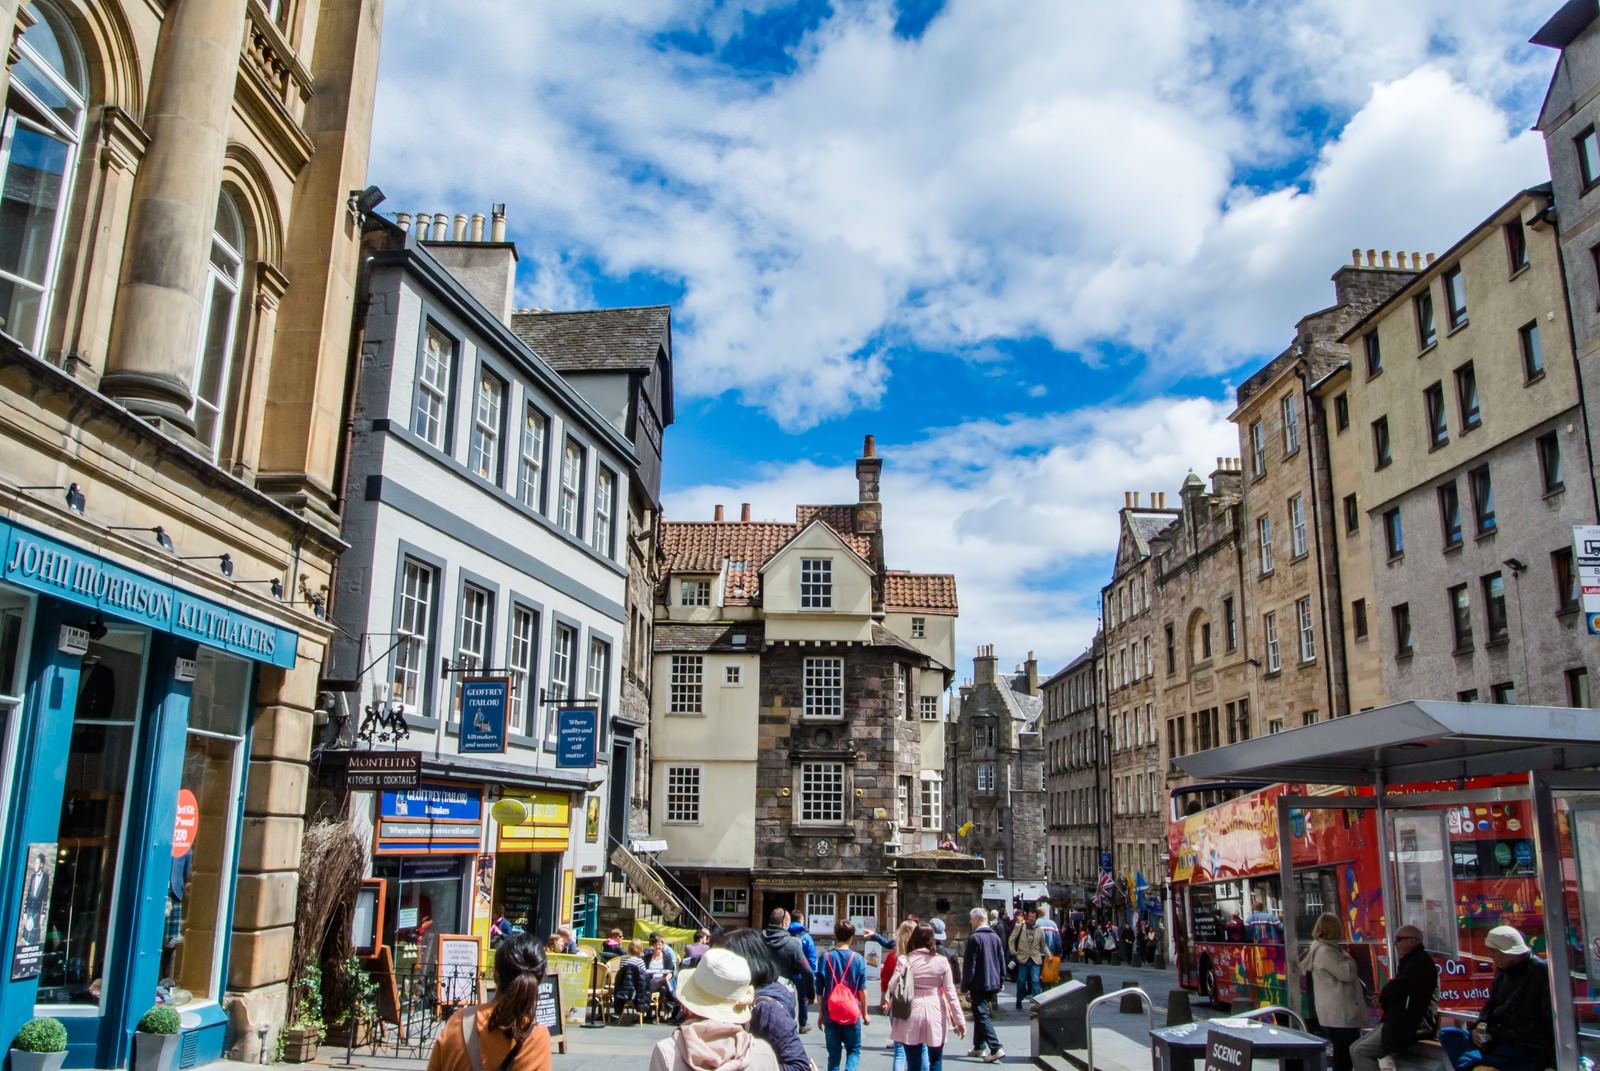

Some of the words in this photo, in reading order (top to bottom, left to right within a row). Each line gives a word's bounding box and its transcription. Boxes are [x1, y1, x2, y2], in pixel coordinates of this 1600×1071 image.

[9, 538, 71, 586] JOHN
[73, 560, 171, 622] MORRISON
[178, 600, 275, 655] KILTMAKERS
[466, 688, 503, 696] GEOFFREY
[467, 733, 498, 741] kiltmakers
[348, 755, 417, 768] MONTEITHS
[347, 775, 374, 785] KITCHEN
[383, 775, 417, 785] COCKTAILS
[406, 789, 441, 802] GEOFFREY
[1446, 959, 1466, 975] On
[1463, 987, 1490, 999] valid
[1212, 1042, 1243, 1066] SCENIC
